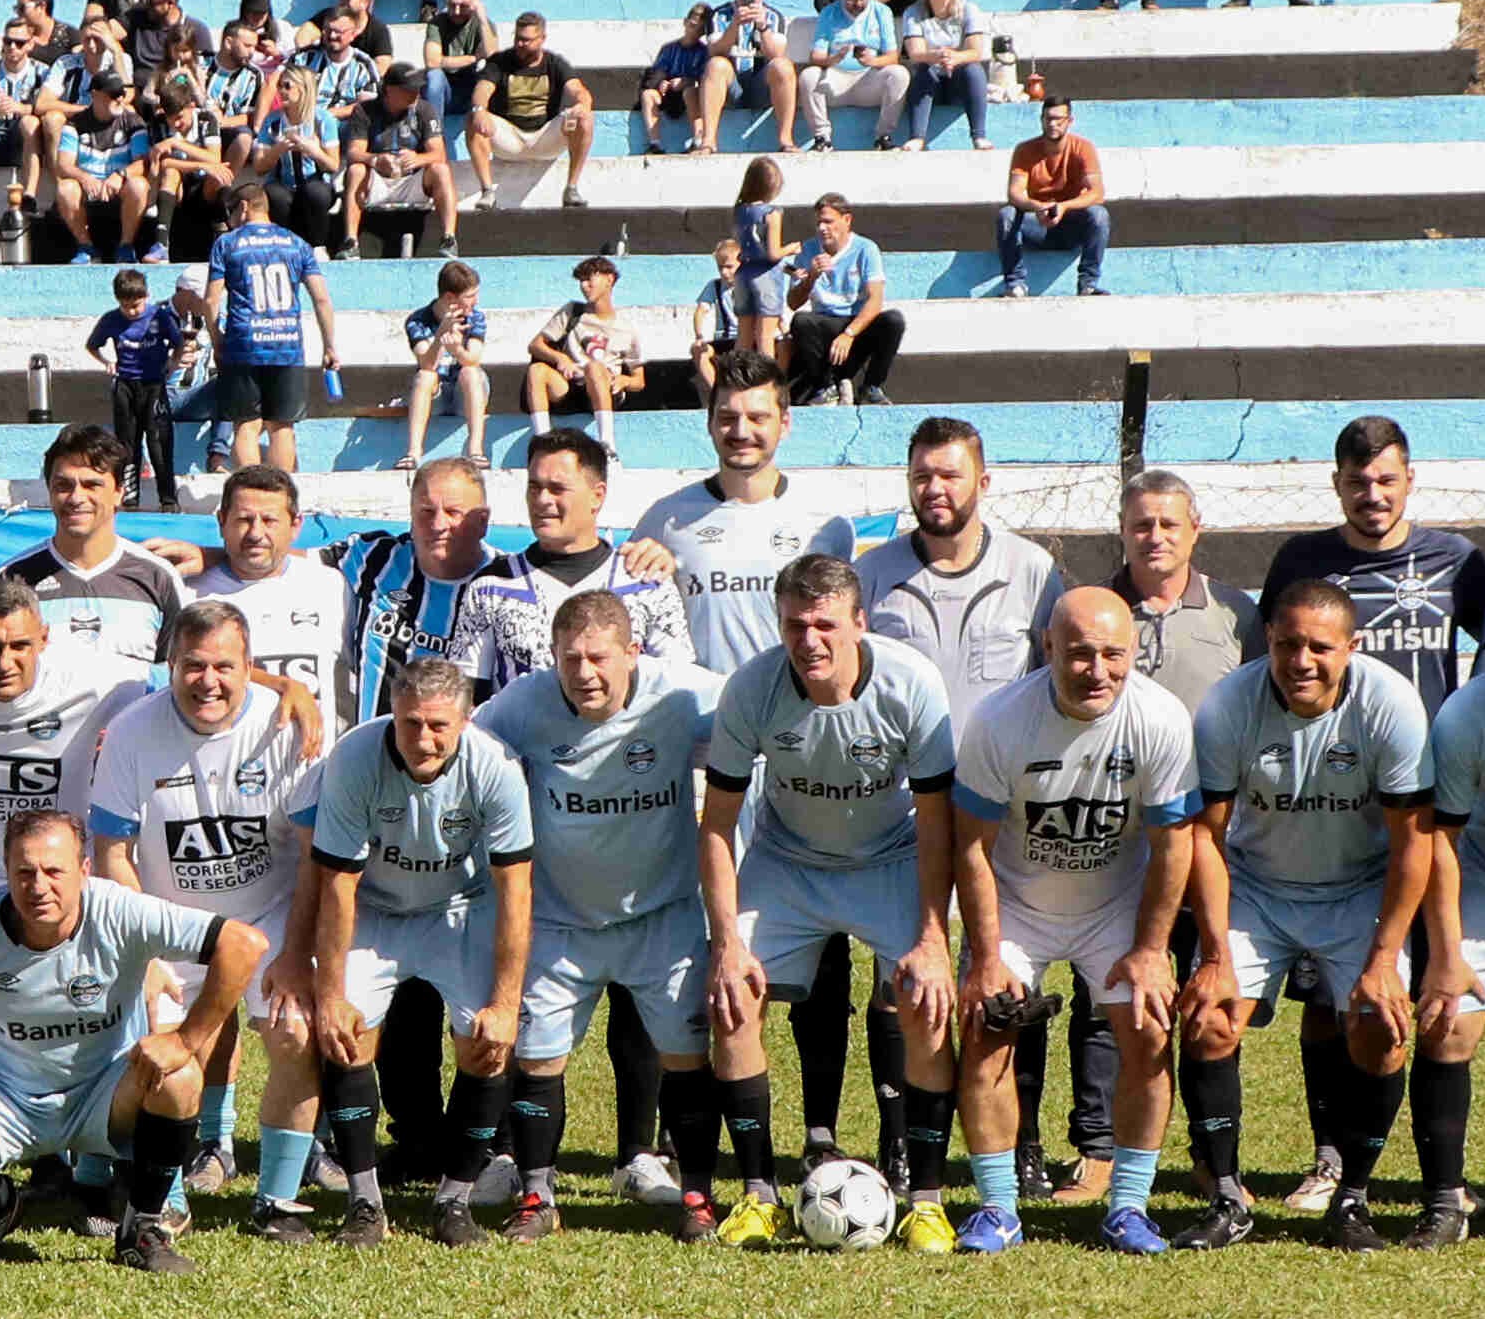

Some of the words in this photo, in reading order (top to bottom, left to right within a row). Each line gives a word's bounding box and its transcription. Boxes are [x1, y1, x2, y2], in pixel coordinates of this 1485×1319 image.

[248, 263, 294, 313] 10
[253, 331, 299, 342] Unimed
[711, 571, 774, 592] Banr
[1357, 615, 1450, 650] nrisul
[566, 781, 676, 814] Banrisul
[171, 819, 267, 860] AIS
[1031, 805, 1126, 842] AIS
[178, 877, 200, 891] DE
[8, 1004, 121, 1041] Banrisul
